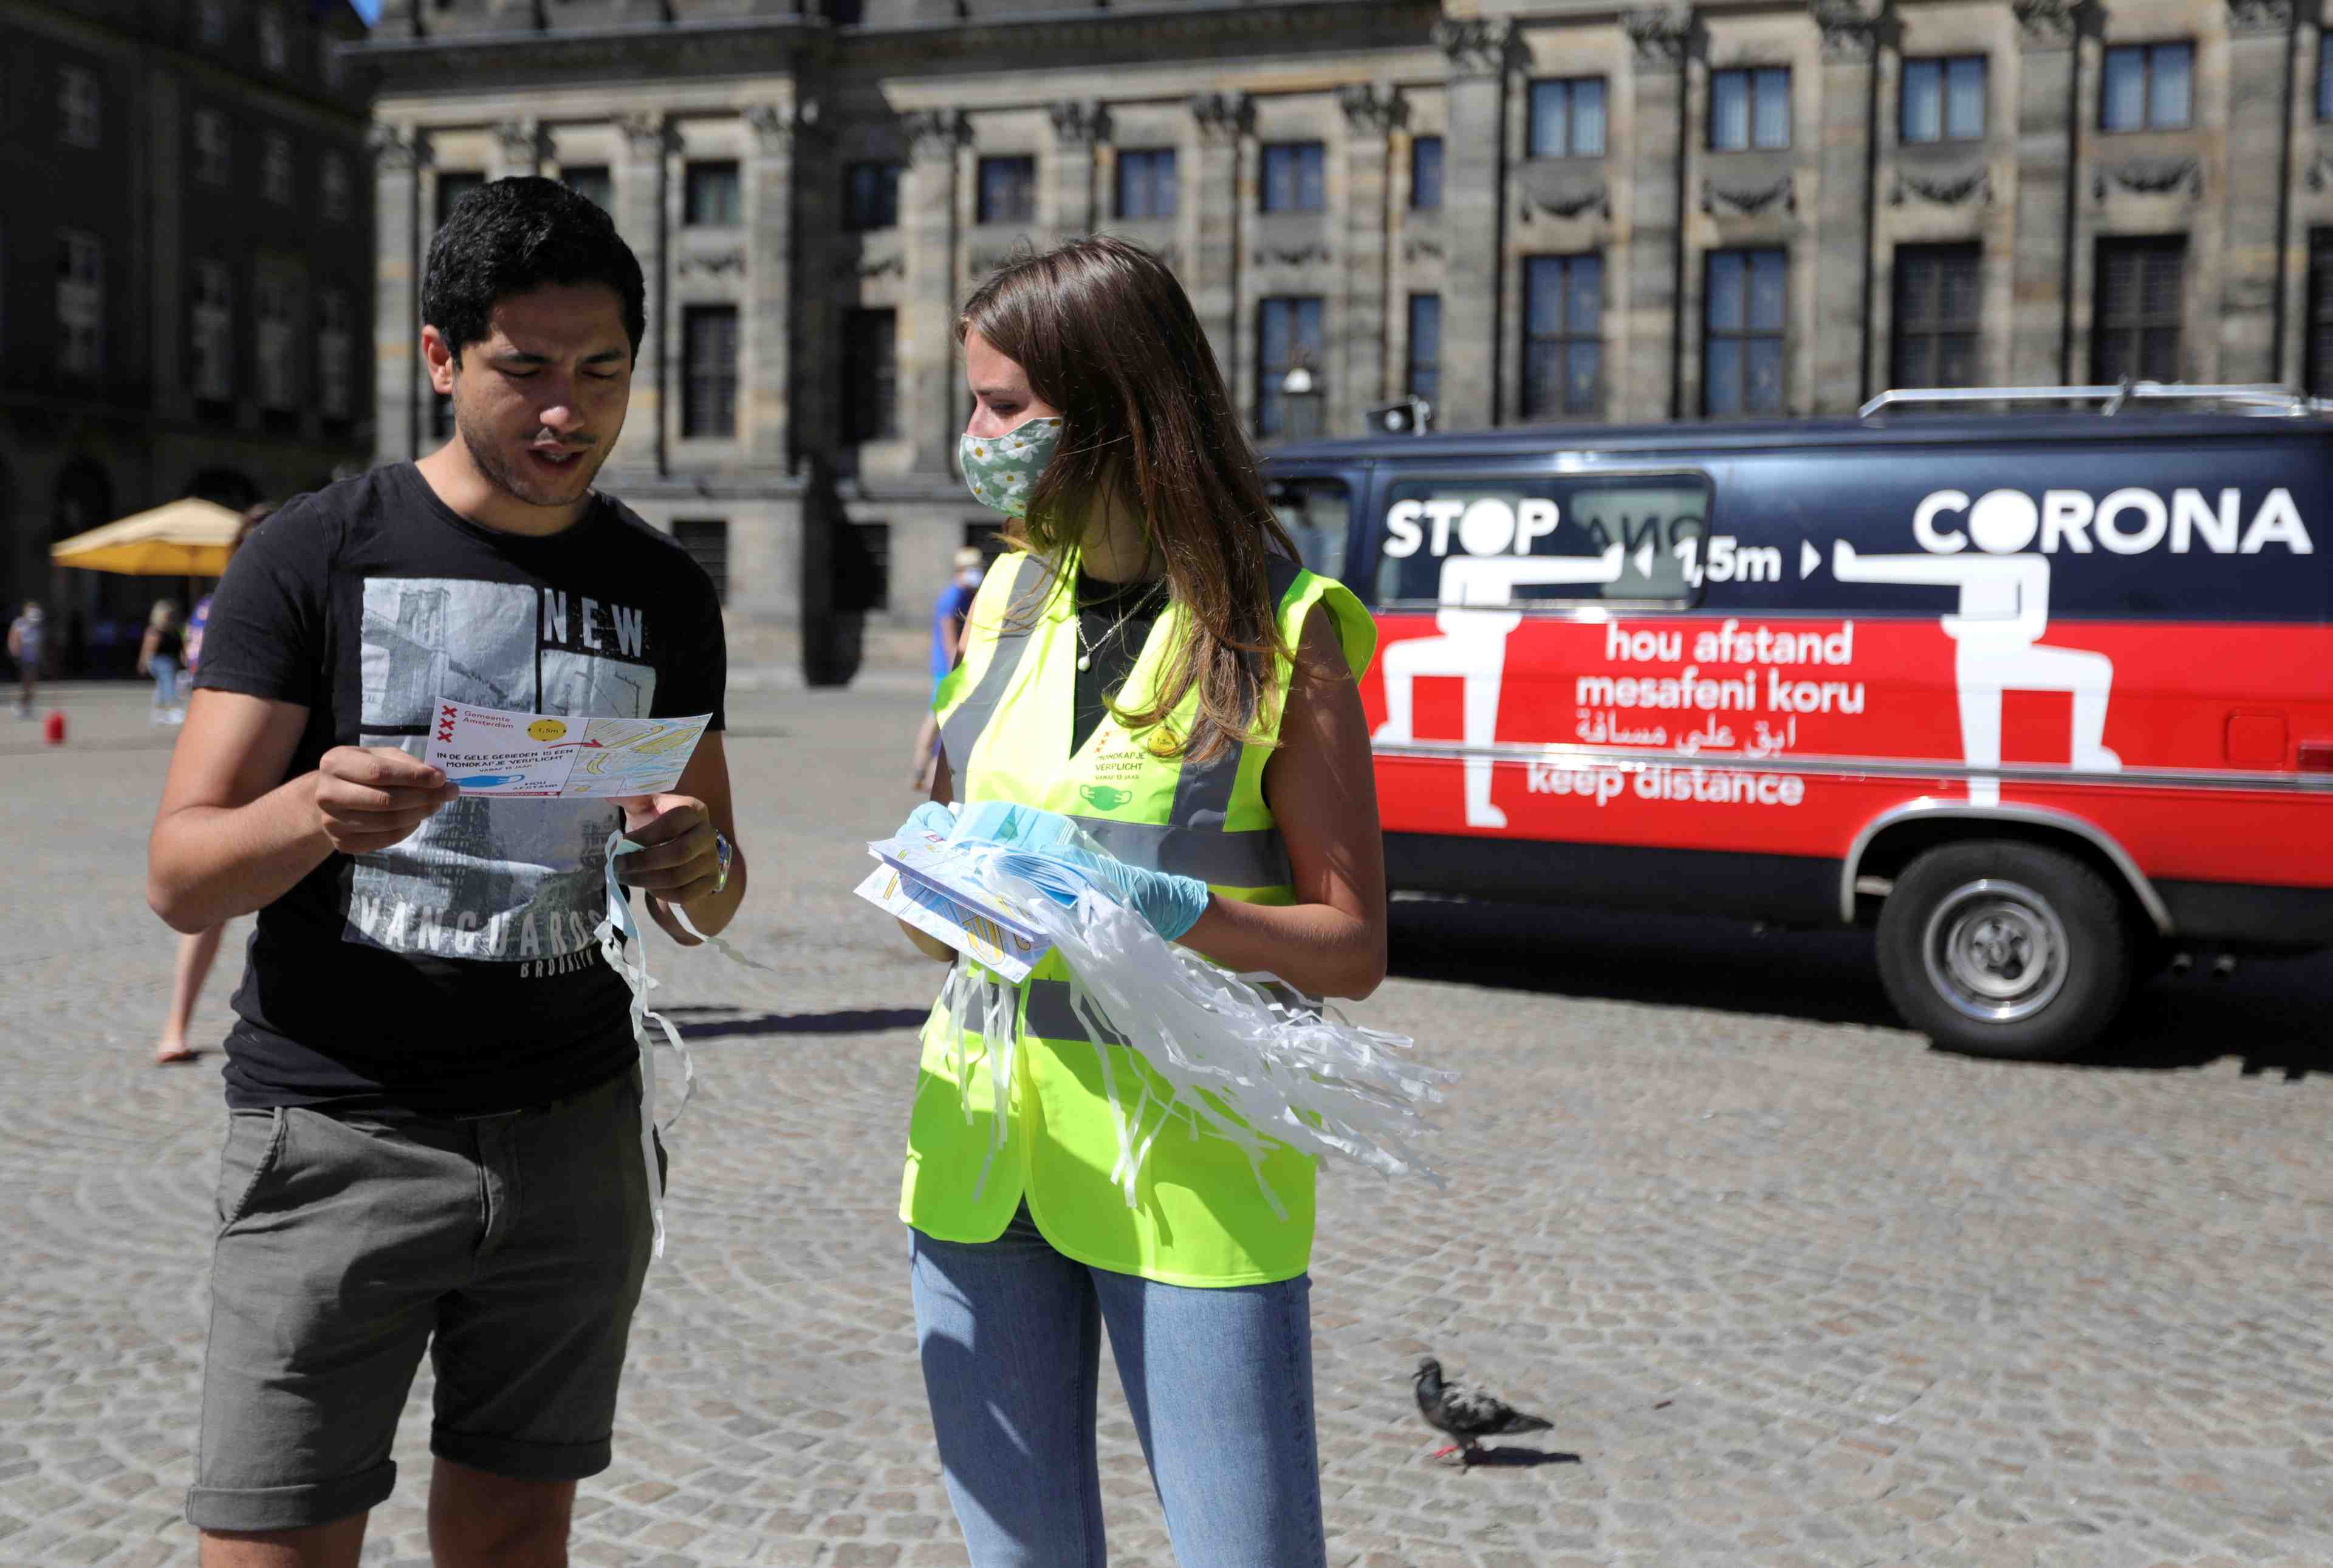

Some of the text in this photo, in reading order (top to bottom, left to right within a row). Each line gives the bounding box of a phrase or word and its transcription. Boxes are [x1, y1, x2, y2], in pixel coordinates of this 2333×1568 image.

[1383, 498, 1560, 557] STOP
[1913, 487, 2314, 555] CORONA
[1673, 535, 1782, 588] 1,5m
[544, 587, 642, 657] NEW
[1605, 619, 1854, 665] hou afstand
[1576, 665, 1865, 714] mesafeni koru
[462, 717, 514, 728] Amsterdam
[464, 710, 510, 722] Gemeente
[510, 755, 564, 764] VERPLICHT
[1527, 761, 1806, 807] keep distance
[520, 947, 594, 978] BROOKLYN
